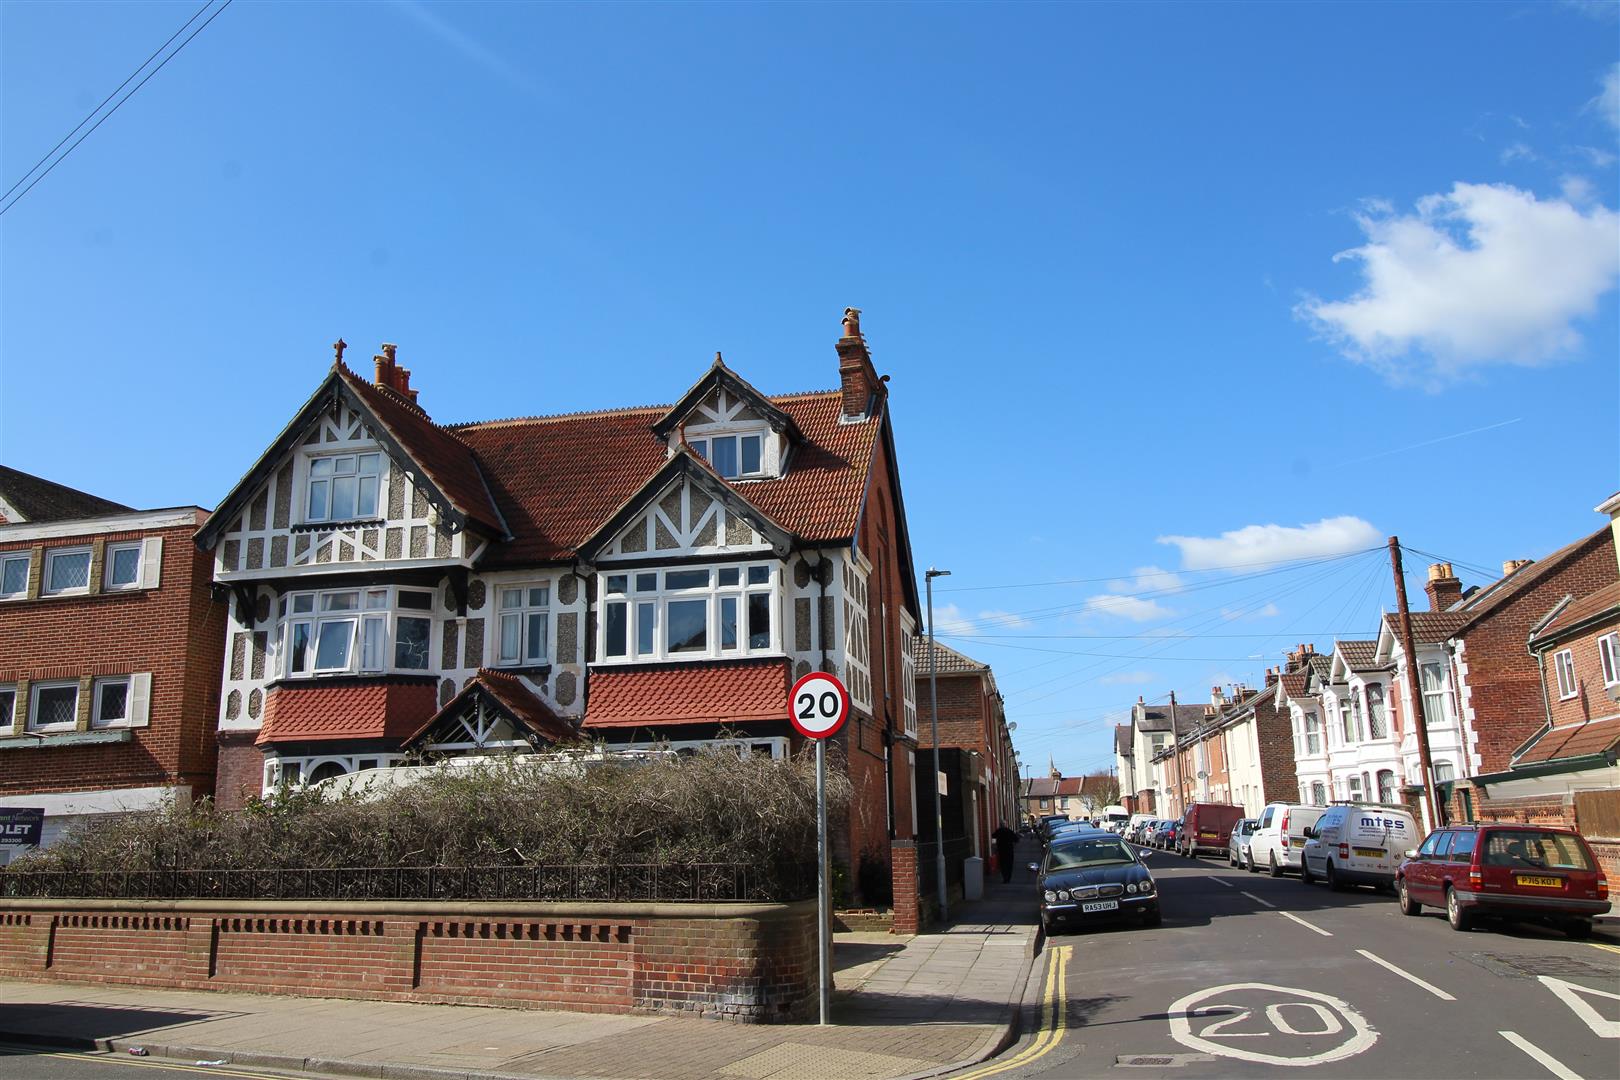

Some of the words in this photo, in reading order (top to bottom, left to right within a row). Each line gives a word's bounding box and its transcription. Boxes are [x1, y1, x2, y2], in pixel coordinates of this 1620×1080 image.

[798, 691, 839, 719] 20
[6, 824, 32, 834] LET
[1360, 816, 1405, 829] mtes
[1084, 903, 1102, 911] RA53
[1194, 1002, 1343, 1036] 20
